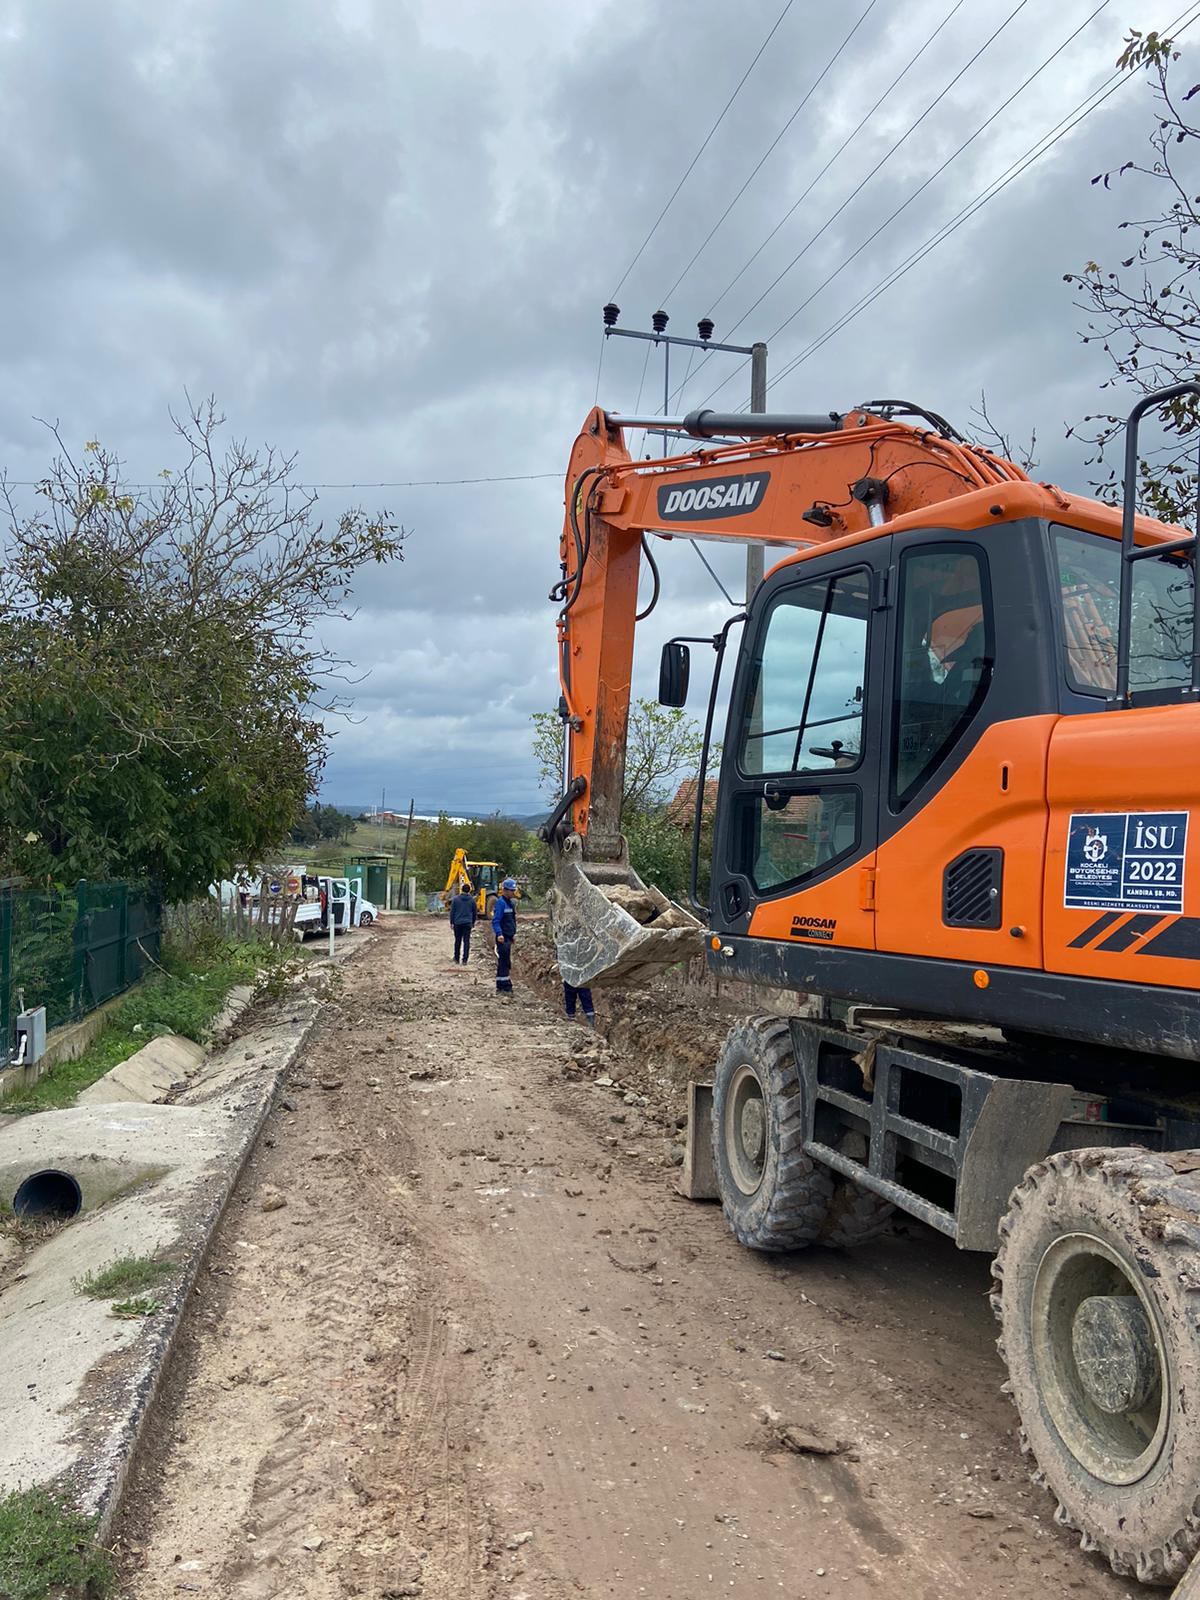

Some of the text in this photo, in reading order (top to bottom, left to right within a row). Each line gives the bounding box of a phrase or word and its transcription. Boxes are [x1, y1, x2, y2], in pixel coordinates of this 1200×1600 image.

[664, 481, 760, 513] DOOSAN
[1129, 861, 1176, 881] 2022
[792, 916, 837, 929] DOOSAN
